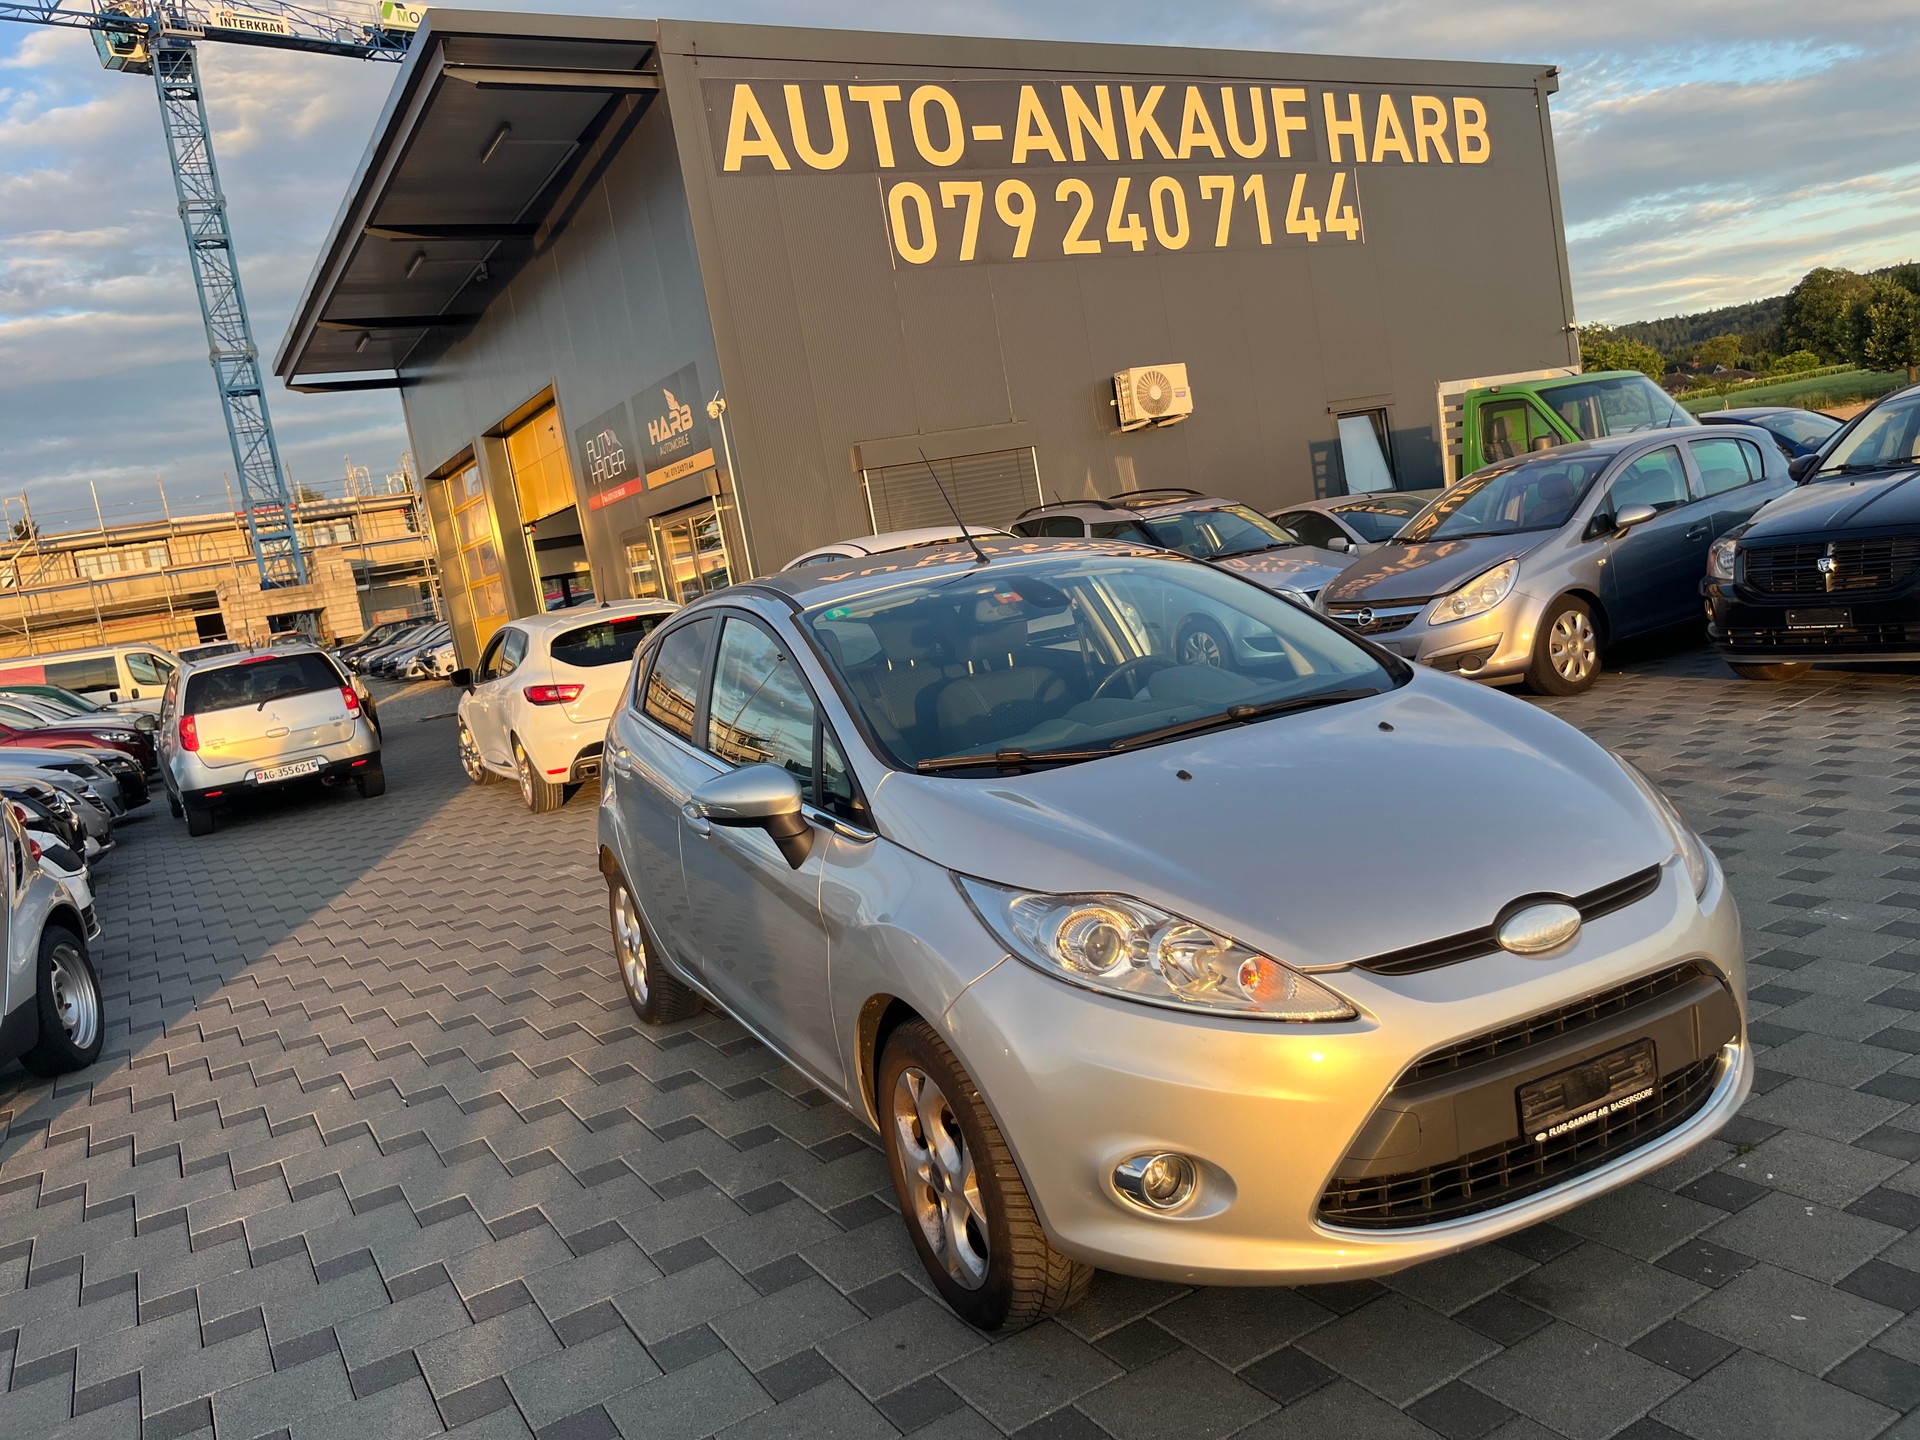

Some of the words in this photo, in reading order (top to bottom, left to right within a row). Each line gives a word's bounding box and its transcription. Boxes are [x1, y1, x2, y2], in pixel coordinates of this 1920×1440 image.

[220, 17, 285, 33] INTERKRAN
[396, 10, 425, 24] MO
[723, 84, 1307, 171] AUTO-ANKAUF
[1323, 92, 1490, 164] HARB
[888, 179, 1036, 264] 079
[648, 404, 693, 445] HARB
[660, 433, 689, 455] AUTOMOBILE
[264, 770, 275, 780] AG
[1548, 1110, 1598, 1137] FLUG-GARAGE
[1598, 1106, 1609, 1117] AG
[1610, 1087, 1653, 1112] BASSERSDORF
